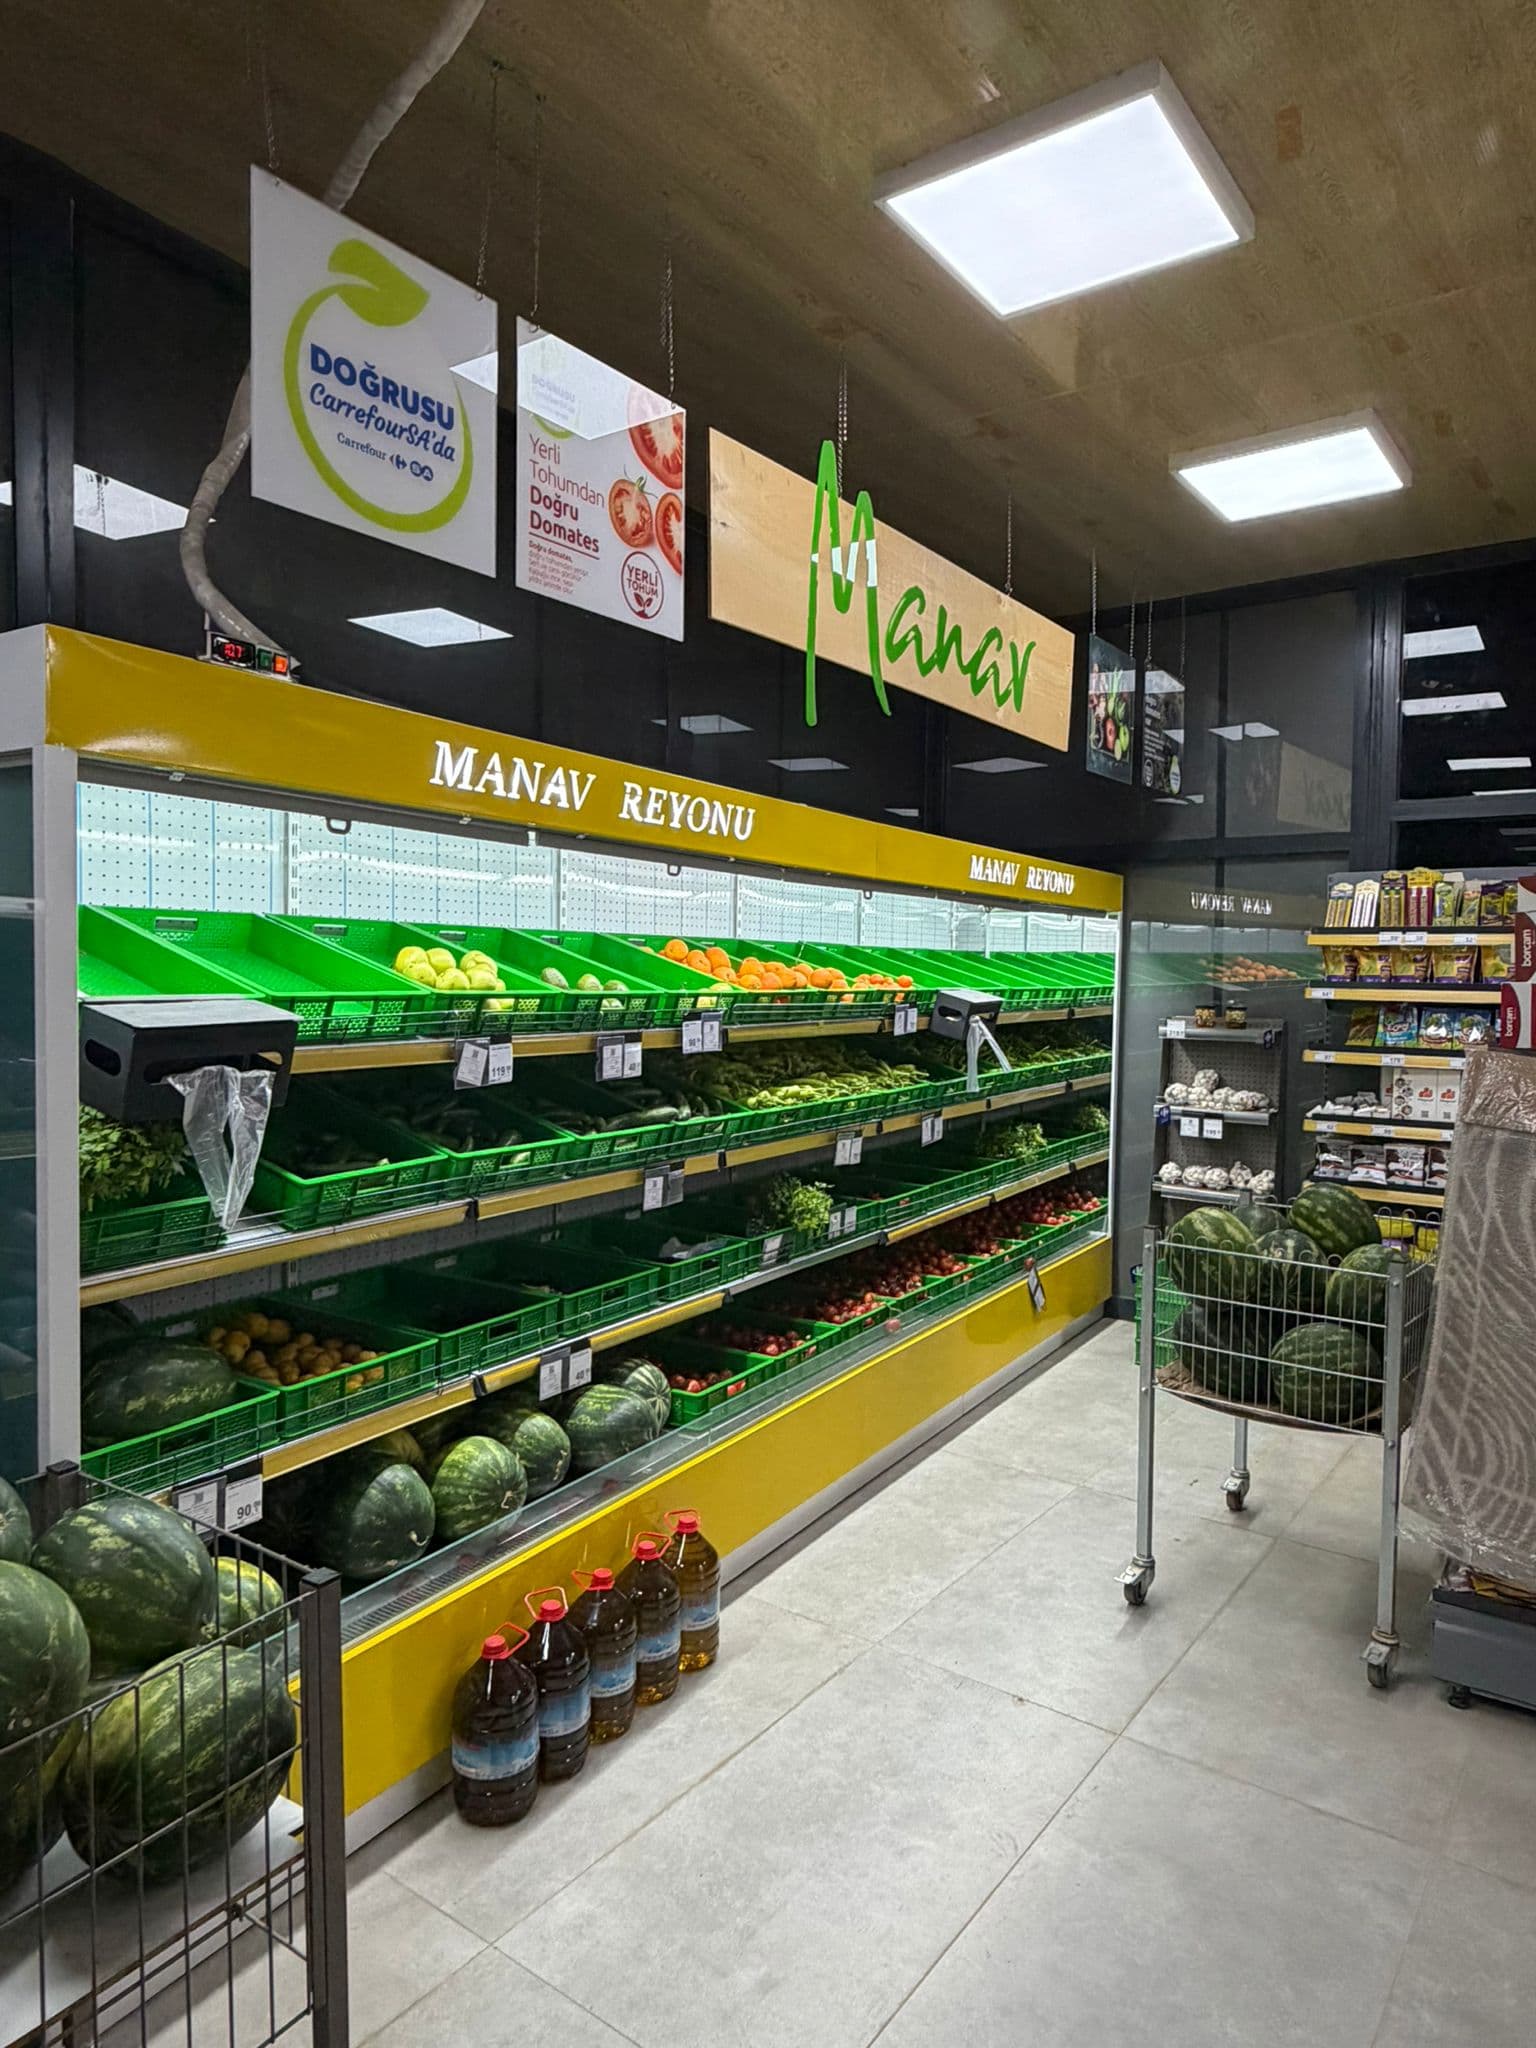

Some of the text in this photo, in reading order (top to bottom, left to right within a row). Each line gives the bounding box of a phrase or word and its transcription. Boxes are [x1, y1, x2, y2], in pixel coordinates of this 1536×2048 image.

[310, 343, 455, 431] DOĞRUSU
[310, 383, 456, 462] CarrefourSA'da
[337, 432, 387, 461] Carrefour
[529, 433, 561, 465] Yerli
[529, 458, 605, 509] Tohumdan
[529, 485, 579, 521] Doğru
[529, 511, 600, 553] Domates
[626, 564, 659, 588] YERLİ
[626, 578, 659, 598] TOHUM
[806, 440, 1037, 727] Manav
[429, 740, 756, 841] MANAV REYONU
[969, 855, 1076, 896] MANAV REYONU
[1521, 928, 1532, 968] borcam
[1505, 1006, 1514, 1037] borcam
[237, 1504, 252, 1519] 90
